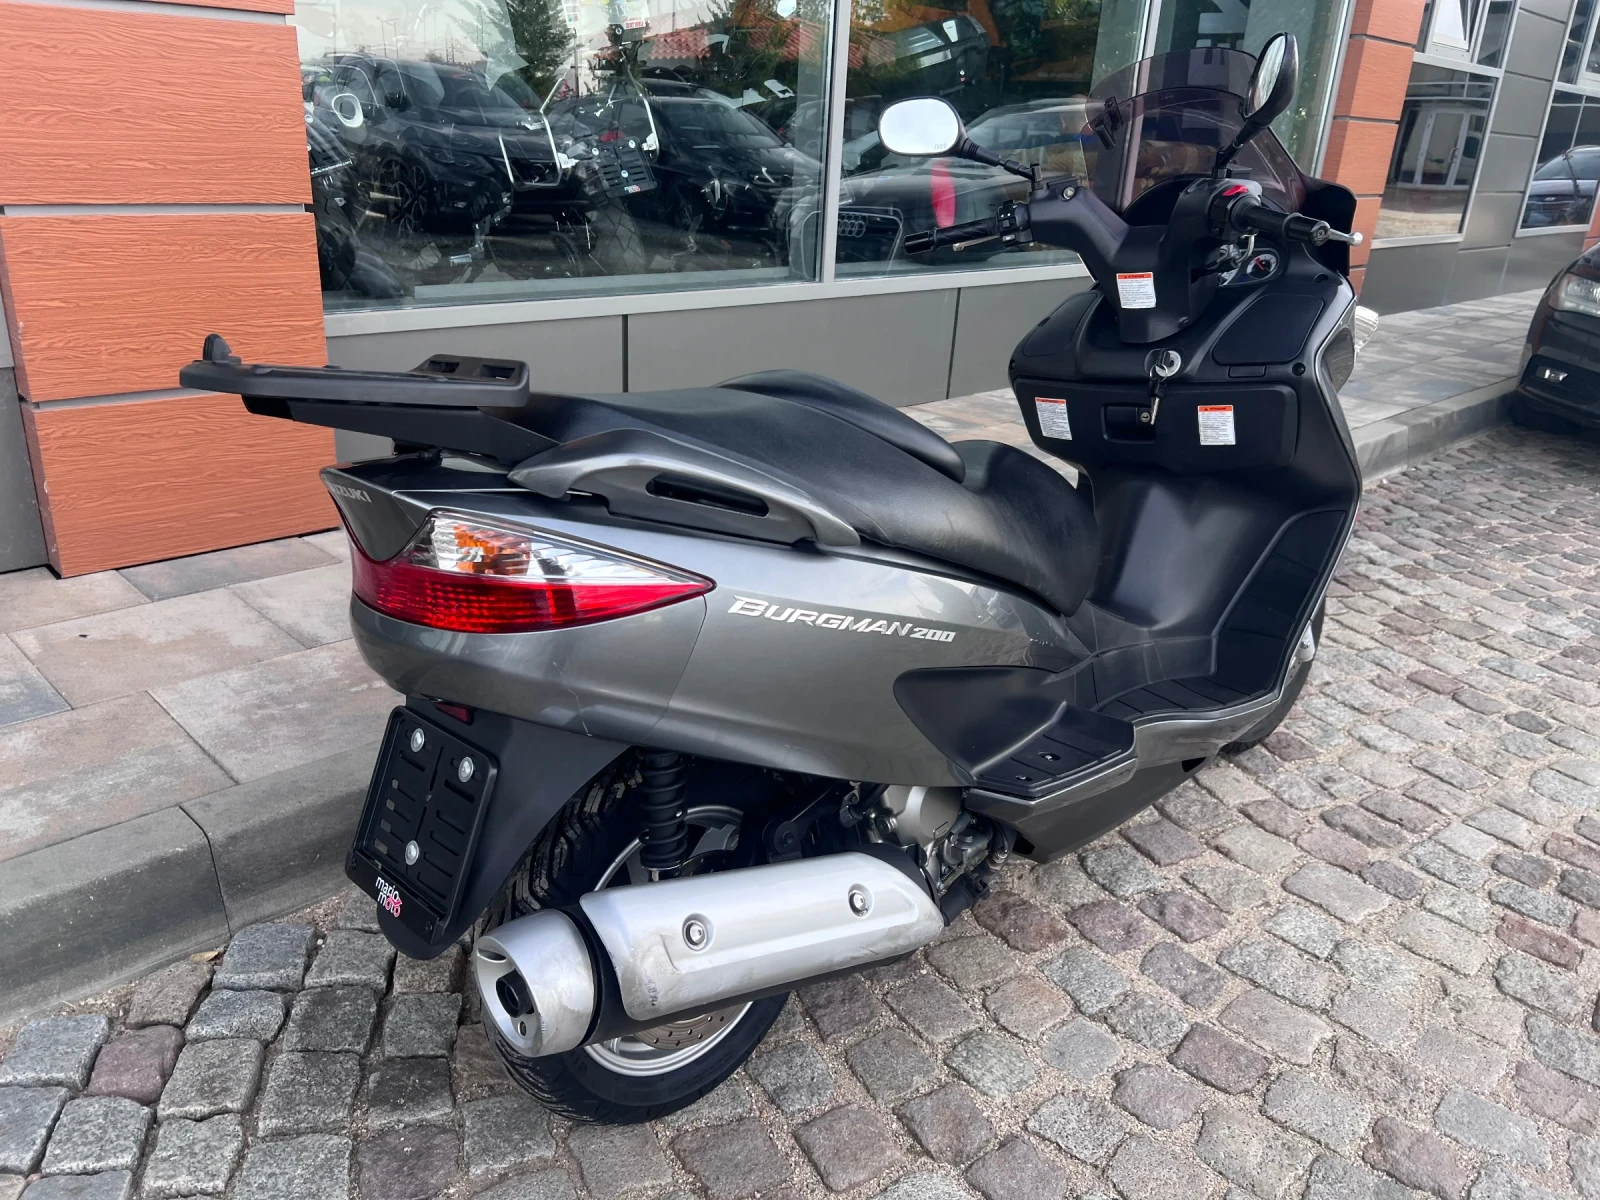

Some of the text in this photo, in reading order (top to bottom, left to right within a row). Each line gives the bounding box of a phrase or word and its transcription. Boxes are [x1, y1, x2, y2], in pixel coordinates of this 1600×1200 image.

[727, 594, 956, 642] BURGMAN 200
[375, 877, 400, 901] mario
[378, 891, 401, 917] moto
